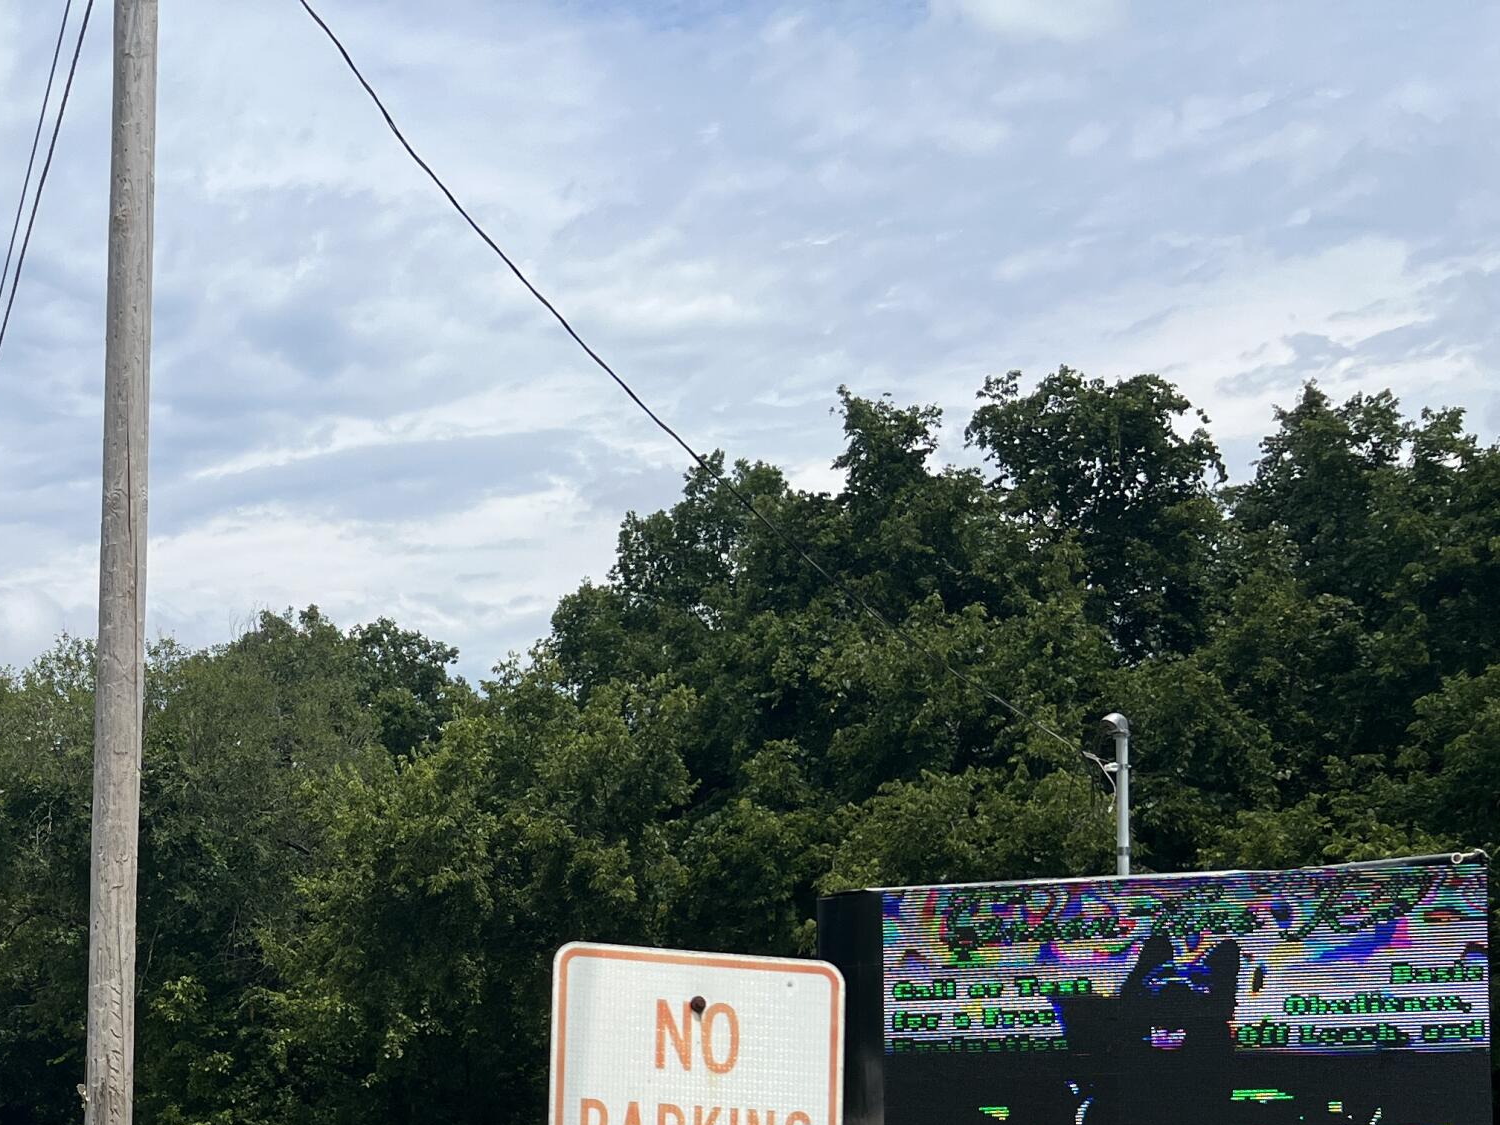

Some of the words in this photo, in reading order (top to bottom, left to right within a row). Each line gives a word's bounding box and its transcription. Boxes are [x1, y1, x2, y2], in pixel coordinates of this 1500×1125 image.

[1391, 961, 1484, 984] Basic
[894, 980, 956, 999] Call
[969, 983, 1003, 998] or
[1015, 977, 1092, 996] Text
[894, 1011, 941, 1030] for
[953, 1013, 971, 1030] a
[654, 998, 739, 1075] NO
[1237, 1021, 1289, 1048] Off
[1421, 1020, 1485, 1043] and
